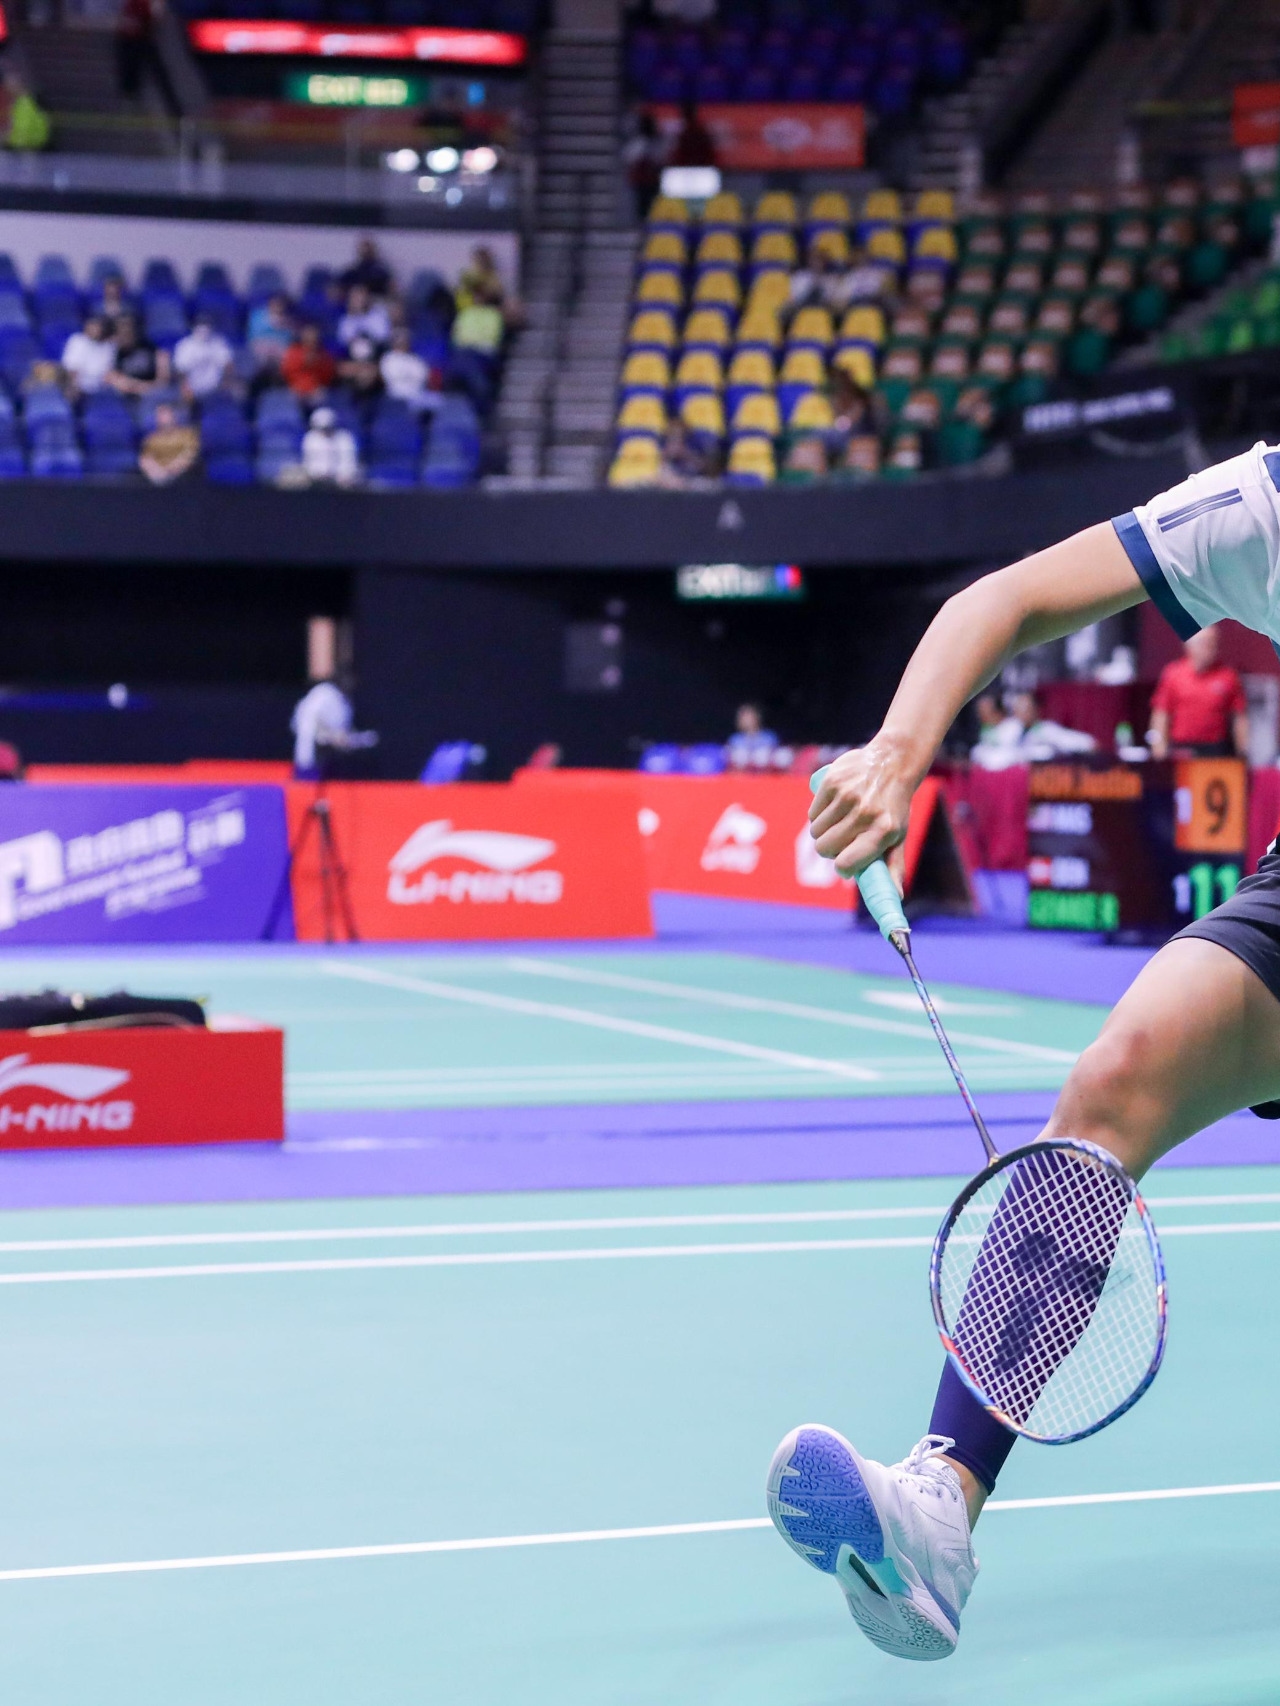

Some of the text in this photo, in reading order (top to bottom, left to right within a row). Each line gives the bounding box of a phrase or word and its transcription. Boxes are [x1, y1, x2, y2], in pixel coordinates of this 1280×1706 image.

[1205, 779, 1229, 836] 9
[387, 870, 564, 905] LI-NING
[1190, 863, 1240, 922] 11
[0, 1101, 135, 1133] I-NING
